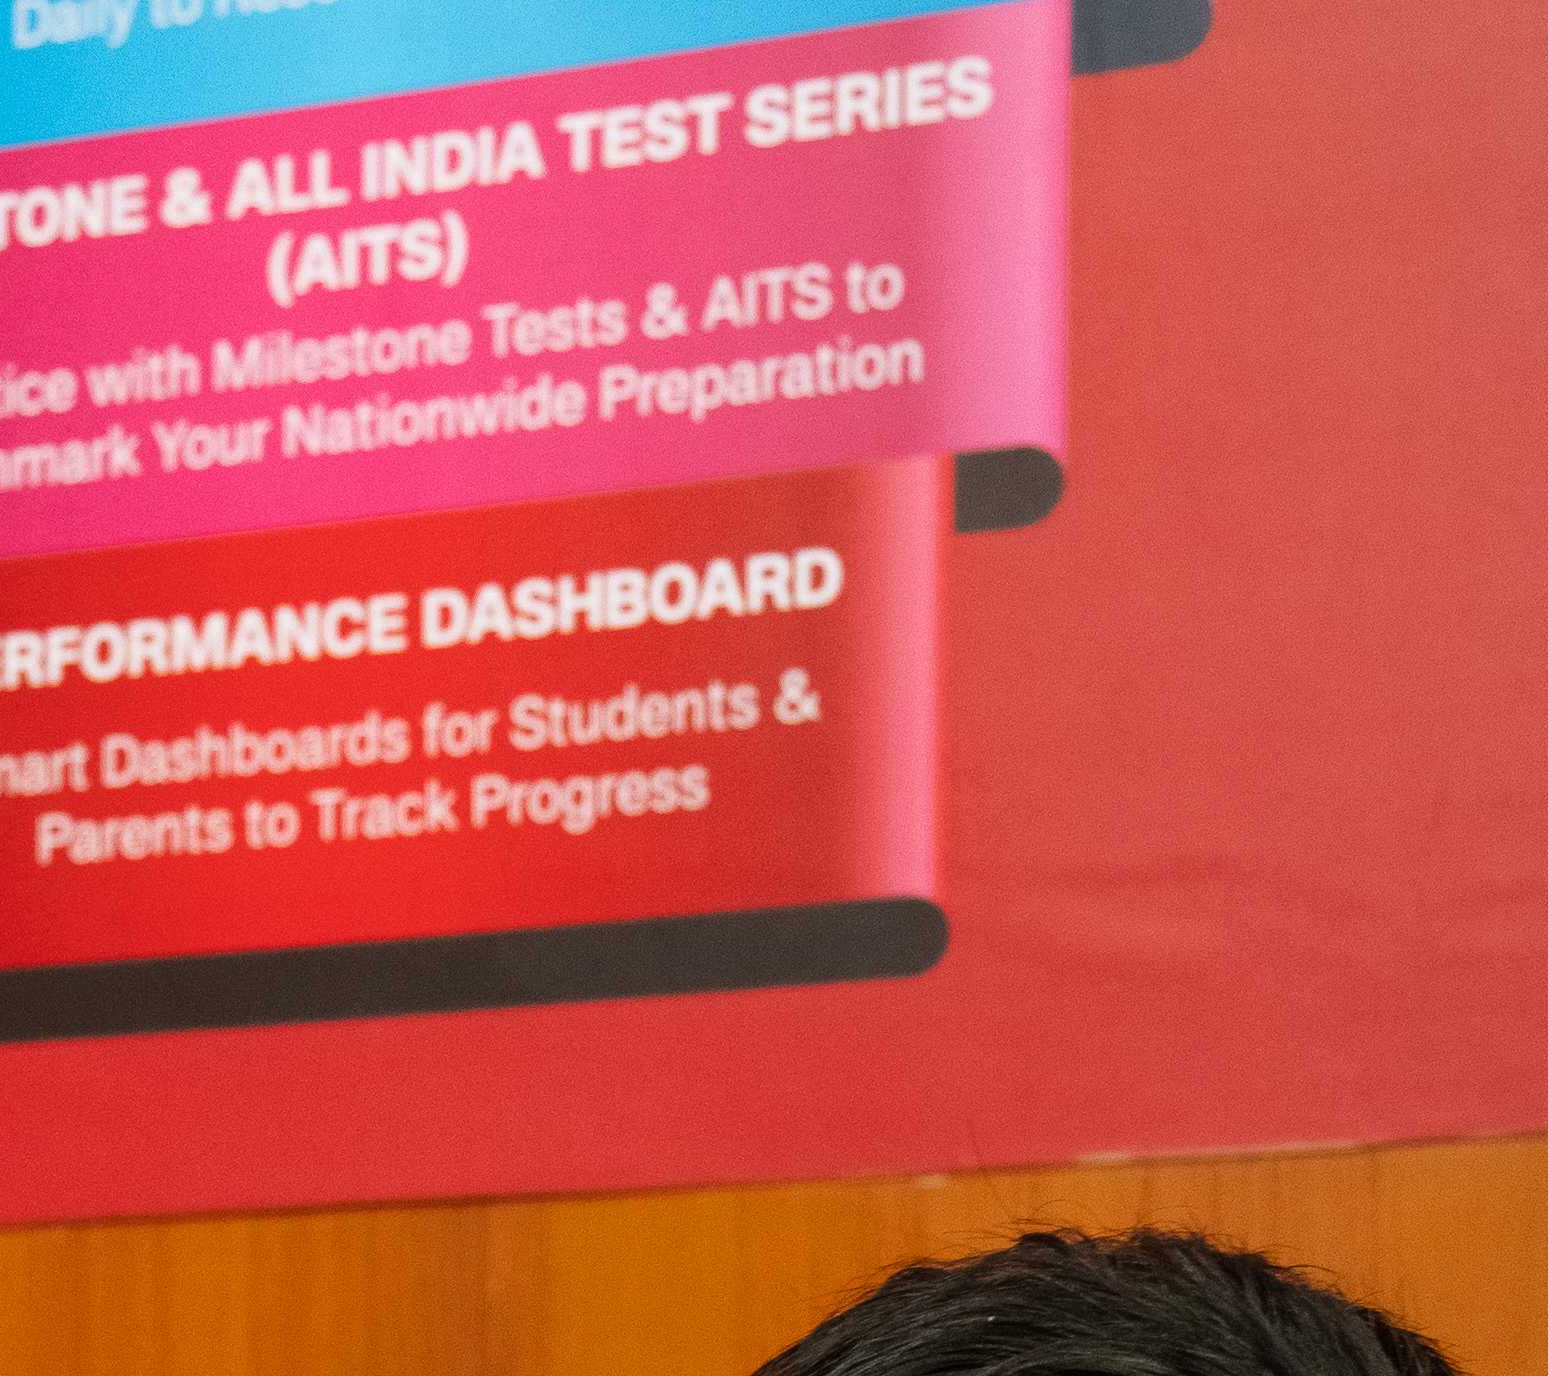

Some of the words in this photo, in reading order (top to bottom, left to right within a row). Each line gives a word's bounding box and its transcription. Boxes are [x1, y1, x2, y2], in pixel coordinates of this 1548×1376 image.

[160, 166, 212, 229] &
[225, 149, 349, 221] ALL
[360, 121, 547, 201] INDIA
[558, 90, 735, 174] TEST
[743, 54, 995, 149] SERIES
[266, 209, 470, 309] (AITS)
[85, 343, 202, 408] with
[209, 318, 473, 394] Milestone
[481, 296, 630, 359] Tests
[640, 282, 689, 341] &
[701, 262, 835, 331] AITS
[845, 261, 905, 313] to
[150, 416, 273, 473] Your
[280, 373, 589, 460] Nationwide
[597, 337, 926, 423] Preparation
[418, 547, 845, 651] DASHBOARD
[99, 709, 413, 790] Dashboards
[420, 700, 501, 760] for
[507, 680, 761, 754] Students
[772, 666, 822, 726] &
[33, 803, 237, 867] Parents
[241, 798, 302, 851] to
[307, 777, 461, 844] Track
[468, 763, 713, 837] Progress
